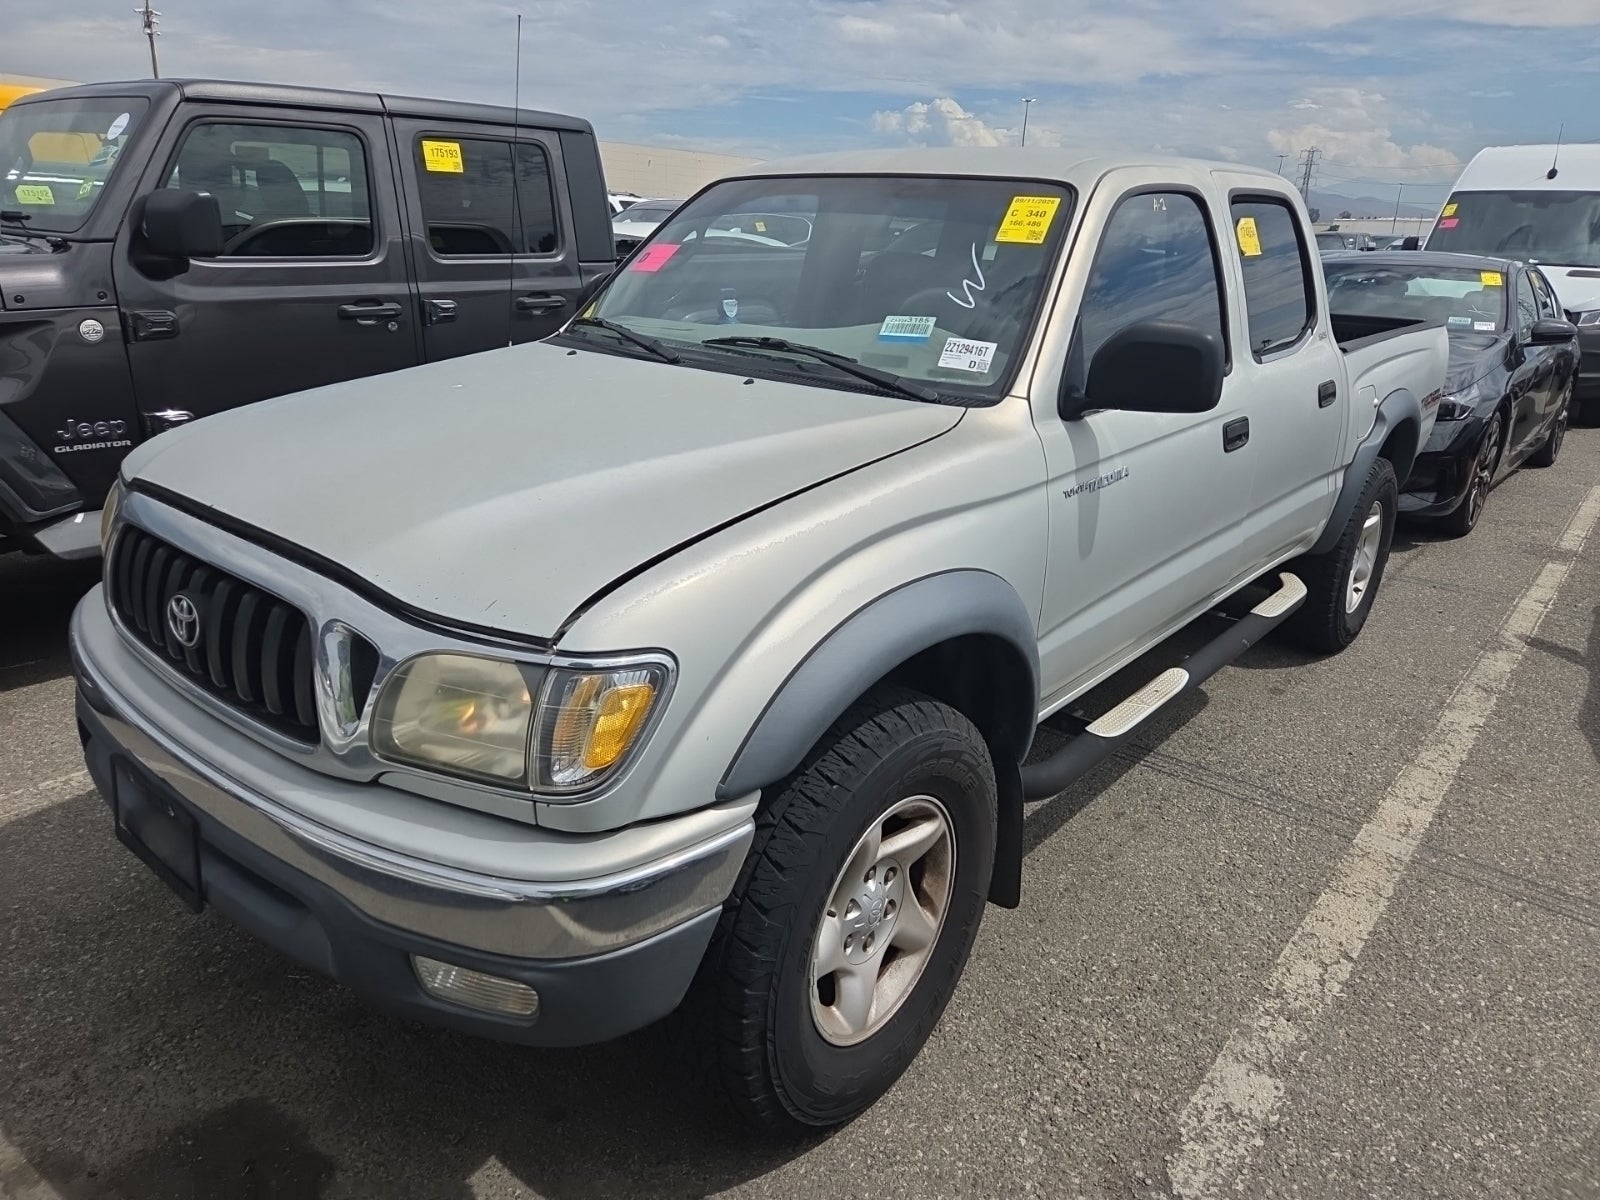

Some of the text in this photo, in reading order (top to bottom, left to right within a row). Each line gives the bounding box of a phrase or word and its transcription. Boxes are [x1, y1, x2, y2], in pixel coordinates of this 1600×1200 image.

[431, 147, 458, 158] 175193
[1010, 208, 1048, 218] C 340
[944, 342, 989, 357] 2Z129416T
[968, 360, 977, 369] D
[57, 419, 126, 440] Jeep
[54, 440, 132, 453] GLADIATOR
